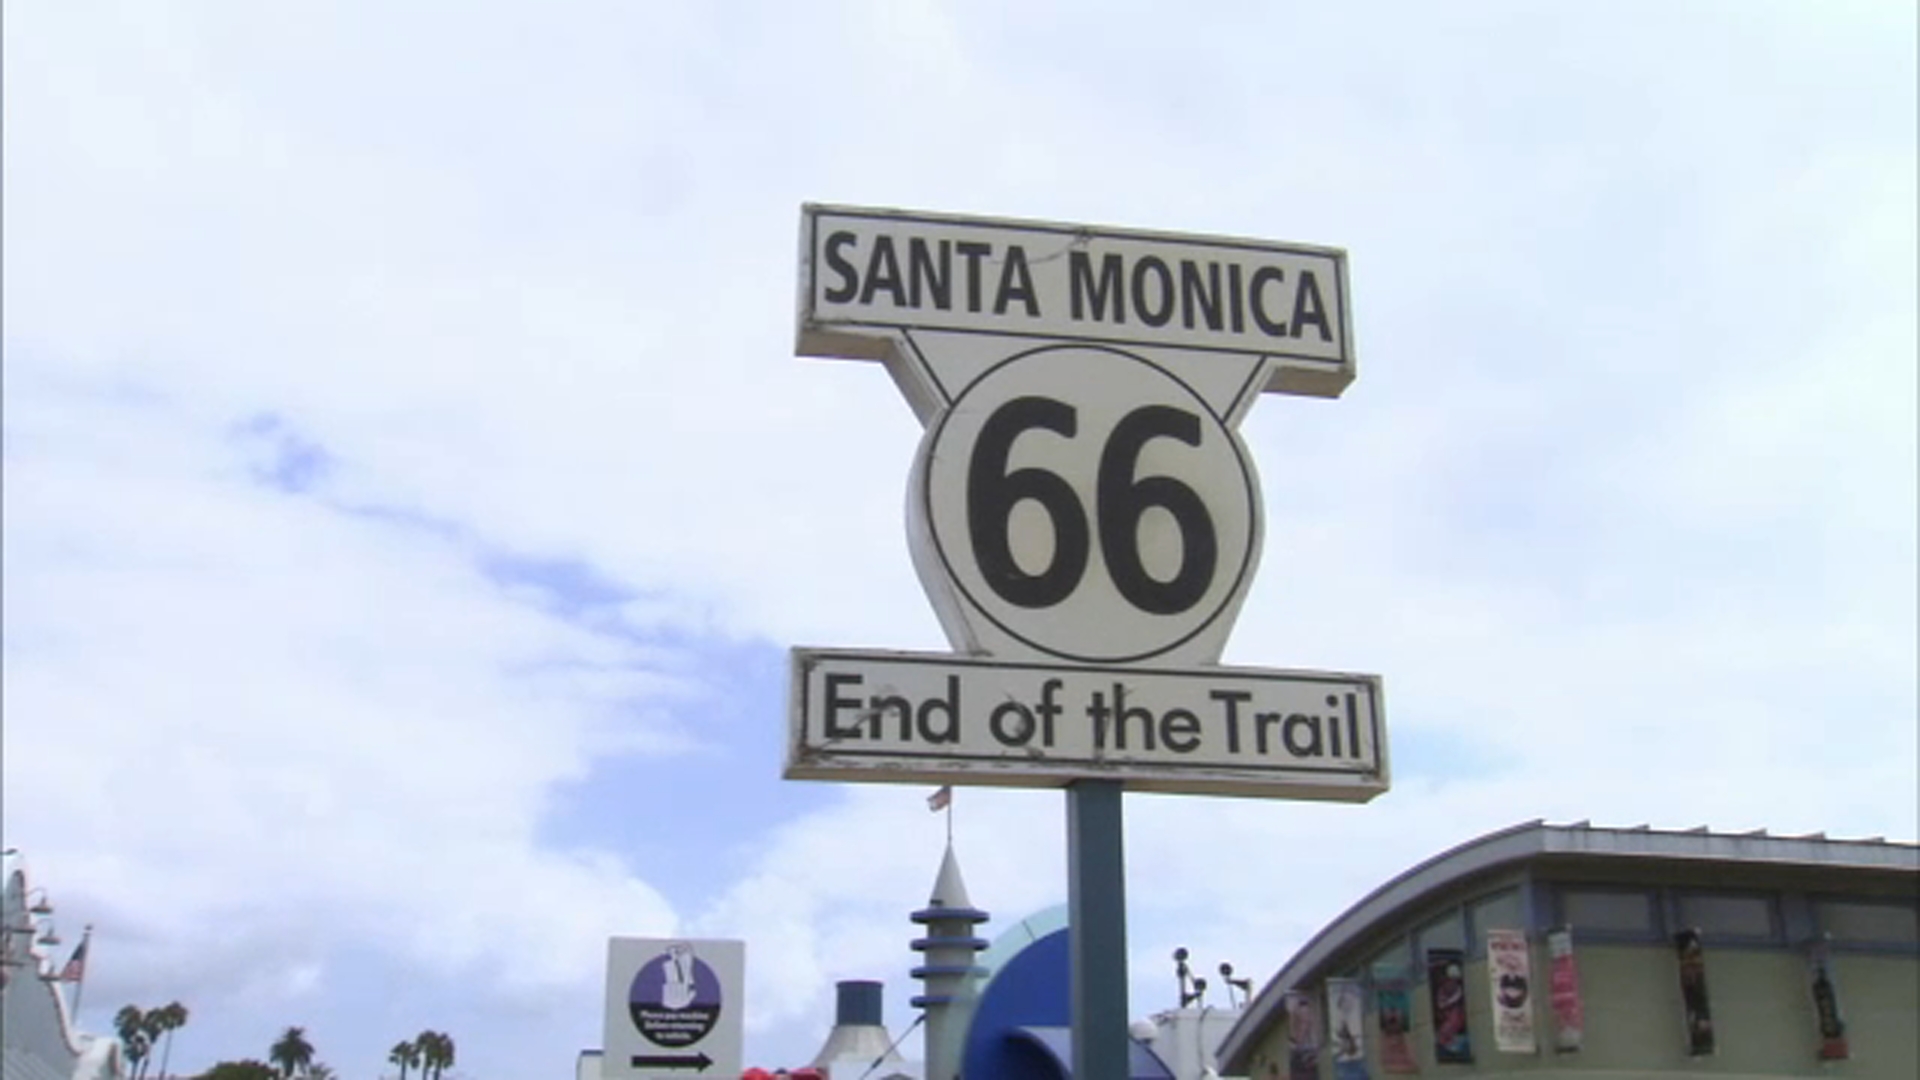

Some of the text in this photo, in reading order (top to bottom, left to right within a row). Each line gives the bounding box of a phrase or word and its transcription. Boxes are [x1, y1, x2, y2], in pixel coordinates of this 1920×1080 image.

[824, 230, 1333, 343] SANTA MONICA
[967, 395, 1218, 616] 66
[823, 673, 1362, 760] End of the Trail
